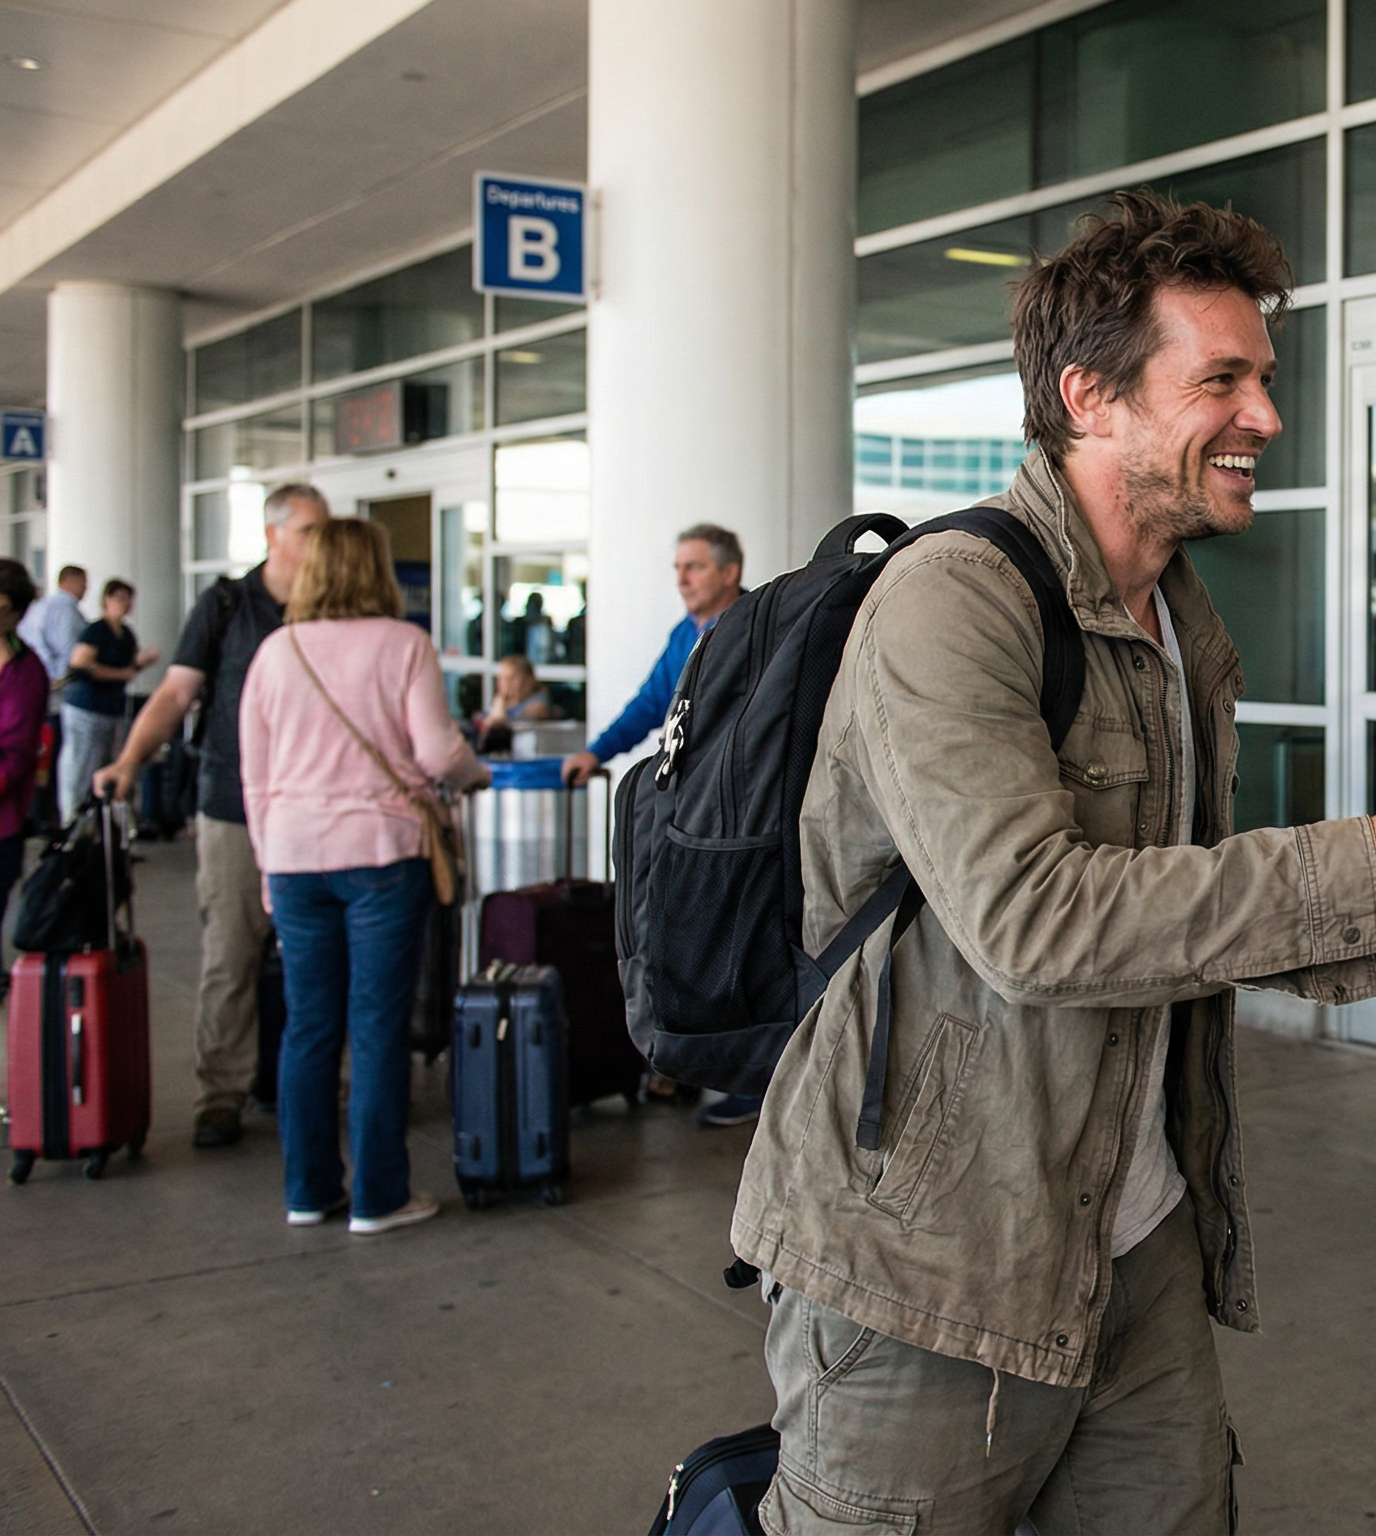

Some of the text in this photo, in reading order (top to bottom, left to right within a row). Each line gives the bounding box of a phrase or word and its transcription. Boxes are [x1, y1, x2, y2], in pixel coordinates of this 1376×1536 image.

[486, 184, 579, 214] Departures
[508, 214, 561, 283] B
[10, 427, 39, 456] A
